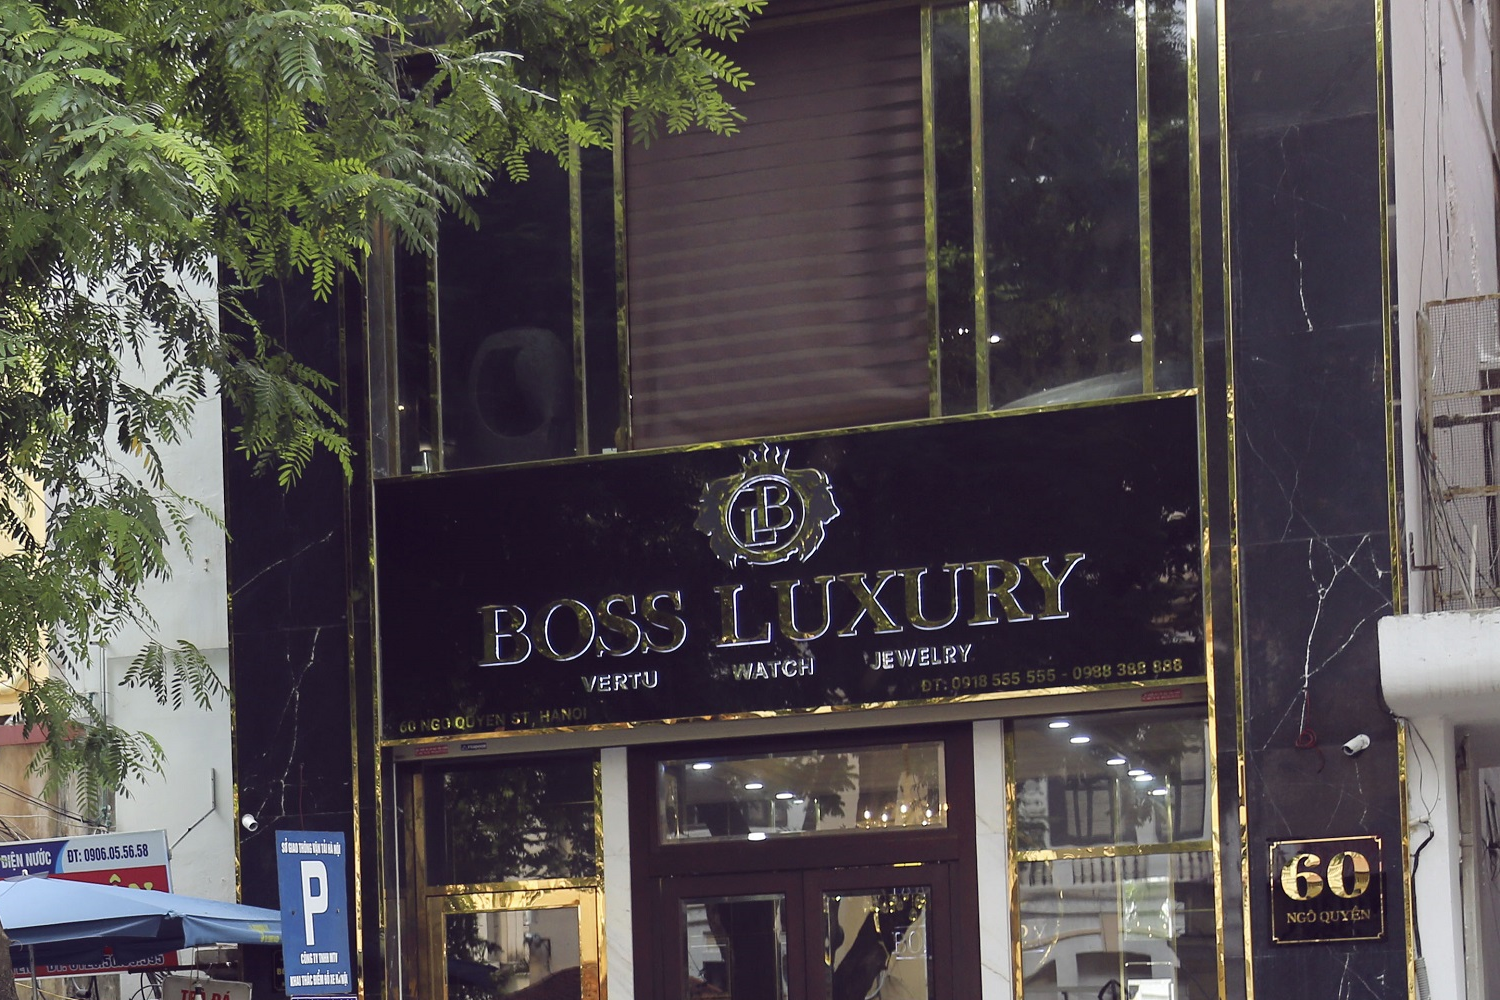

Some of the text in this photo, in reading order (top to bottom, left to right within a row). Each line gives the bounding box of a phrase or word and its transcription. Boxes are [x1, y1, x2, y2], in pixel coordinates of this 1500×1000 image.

[477, 553, 1086, 667] BOSS LUXURY
[868, 643, 972, 671] JEWELRY
[732, 657, 814, 681] WATCH
[951, 674, 988, 689] 0918
[992, 671, 1020, 687] 555
[1026, 668, 1056, 684] 555
[581, 670, 659, 693] VERTU
[539, 707, 587, 723] HANOI
[25, 847, 52, 867] NƯỚC
[67, 843, 149, 863] ĐT: 0906.05.56.58
[1281, 851, 1370, 901] 60
[300, 860, 329, 946] P
[1286, 909, 1317, 924] NGÔ
